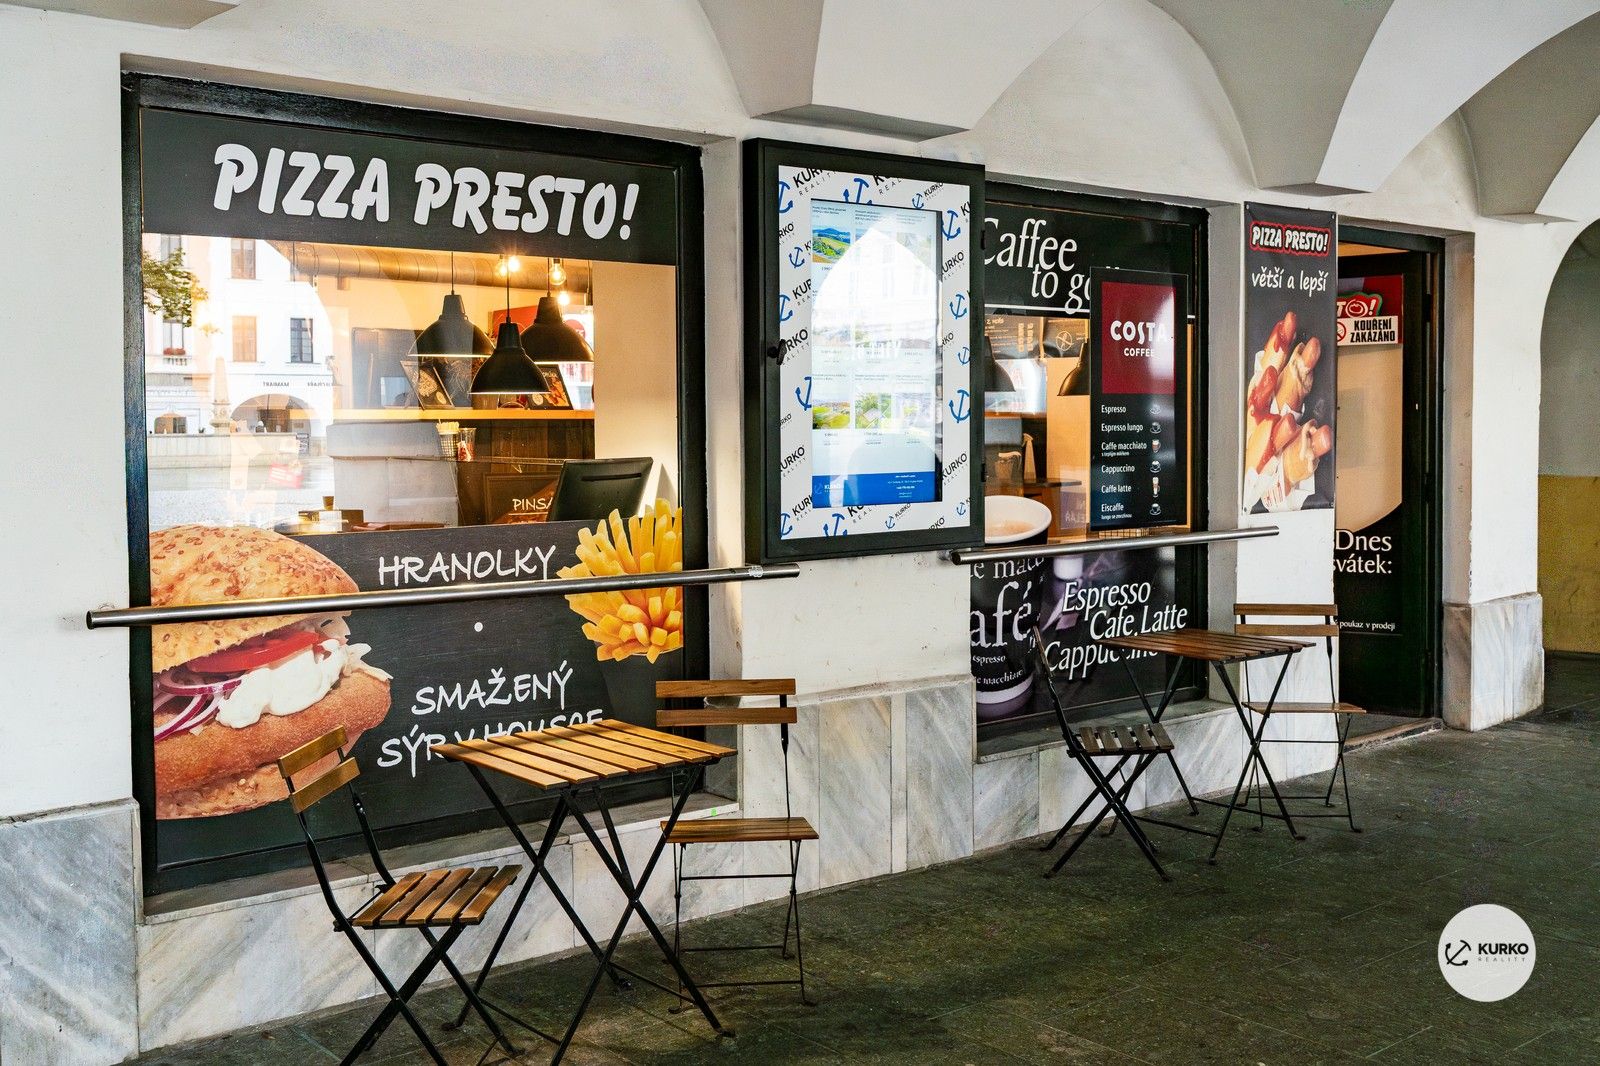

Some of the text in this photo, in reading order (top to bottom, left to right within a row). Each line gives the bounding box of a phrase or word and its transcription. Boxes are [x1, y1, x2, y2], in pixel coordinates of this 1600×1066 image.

[793, 168, 823, 188] KUR
[213, 143, 640, 241] PIZZA PRESTO!
[1252, 226, 1329, 252] PIZZA PRESTO!
[1031, 263, 1059, 299] to
[1251, 266, 1329, 297] větší a lepší
[1354, 317, 1392, 331] KOUŘENÍ
[1350, 329, 1396, 343] ZAKÁZÁNO
[1101, 405, 1126, 415] Espresso
[1101, 422, 1144, 433] Espresso lungo
[1101, 441, 1148, 451] Caffe macchiato
[1101, 463, 1136, 474] Cappuccino
[1101, 484, 1132, 493] Caffe latte
[1101, 502, 1124, 512] Eiscaffe
[1335, 529, 1393, 552] Dnes
[378, 545, 556, 585] HRANOLKY
[1062, 582, 1151, 621] Espresso
[1339, 620, 1363, 629] poukaz
[1371, 622, 1396, 631] prodeji
[411, 660, 573, 715] SMAŽENÝ
